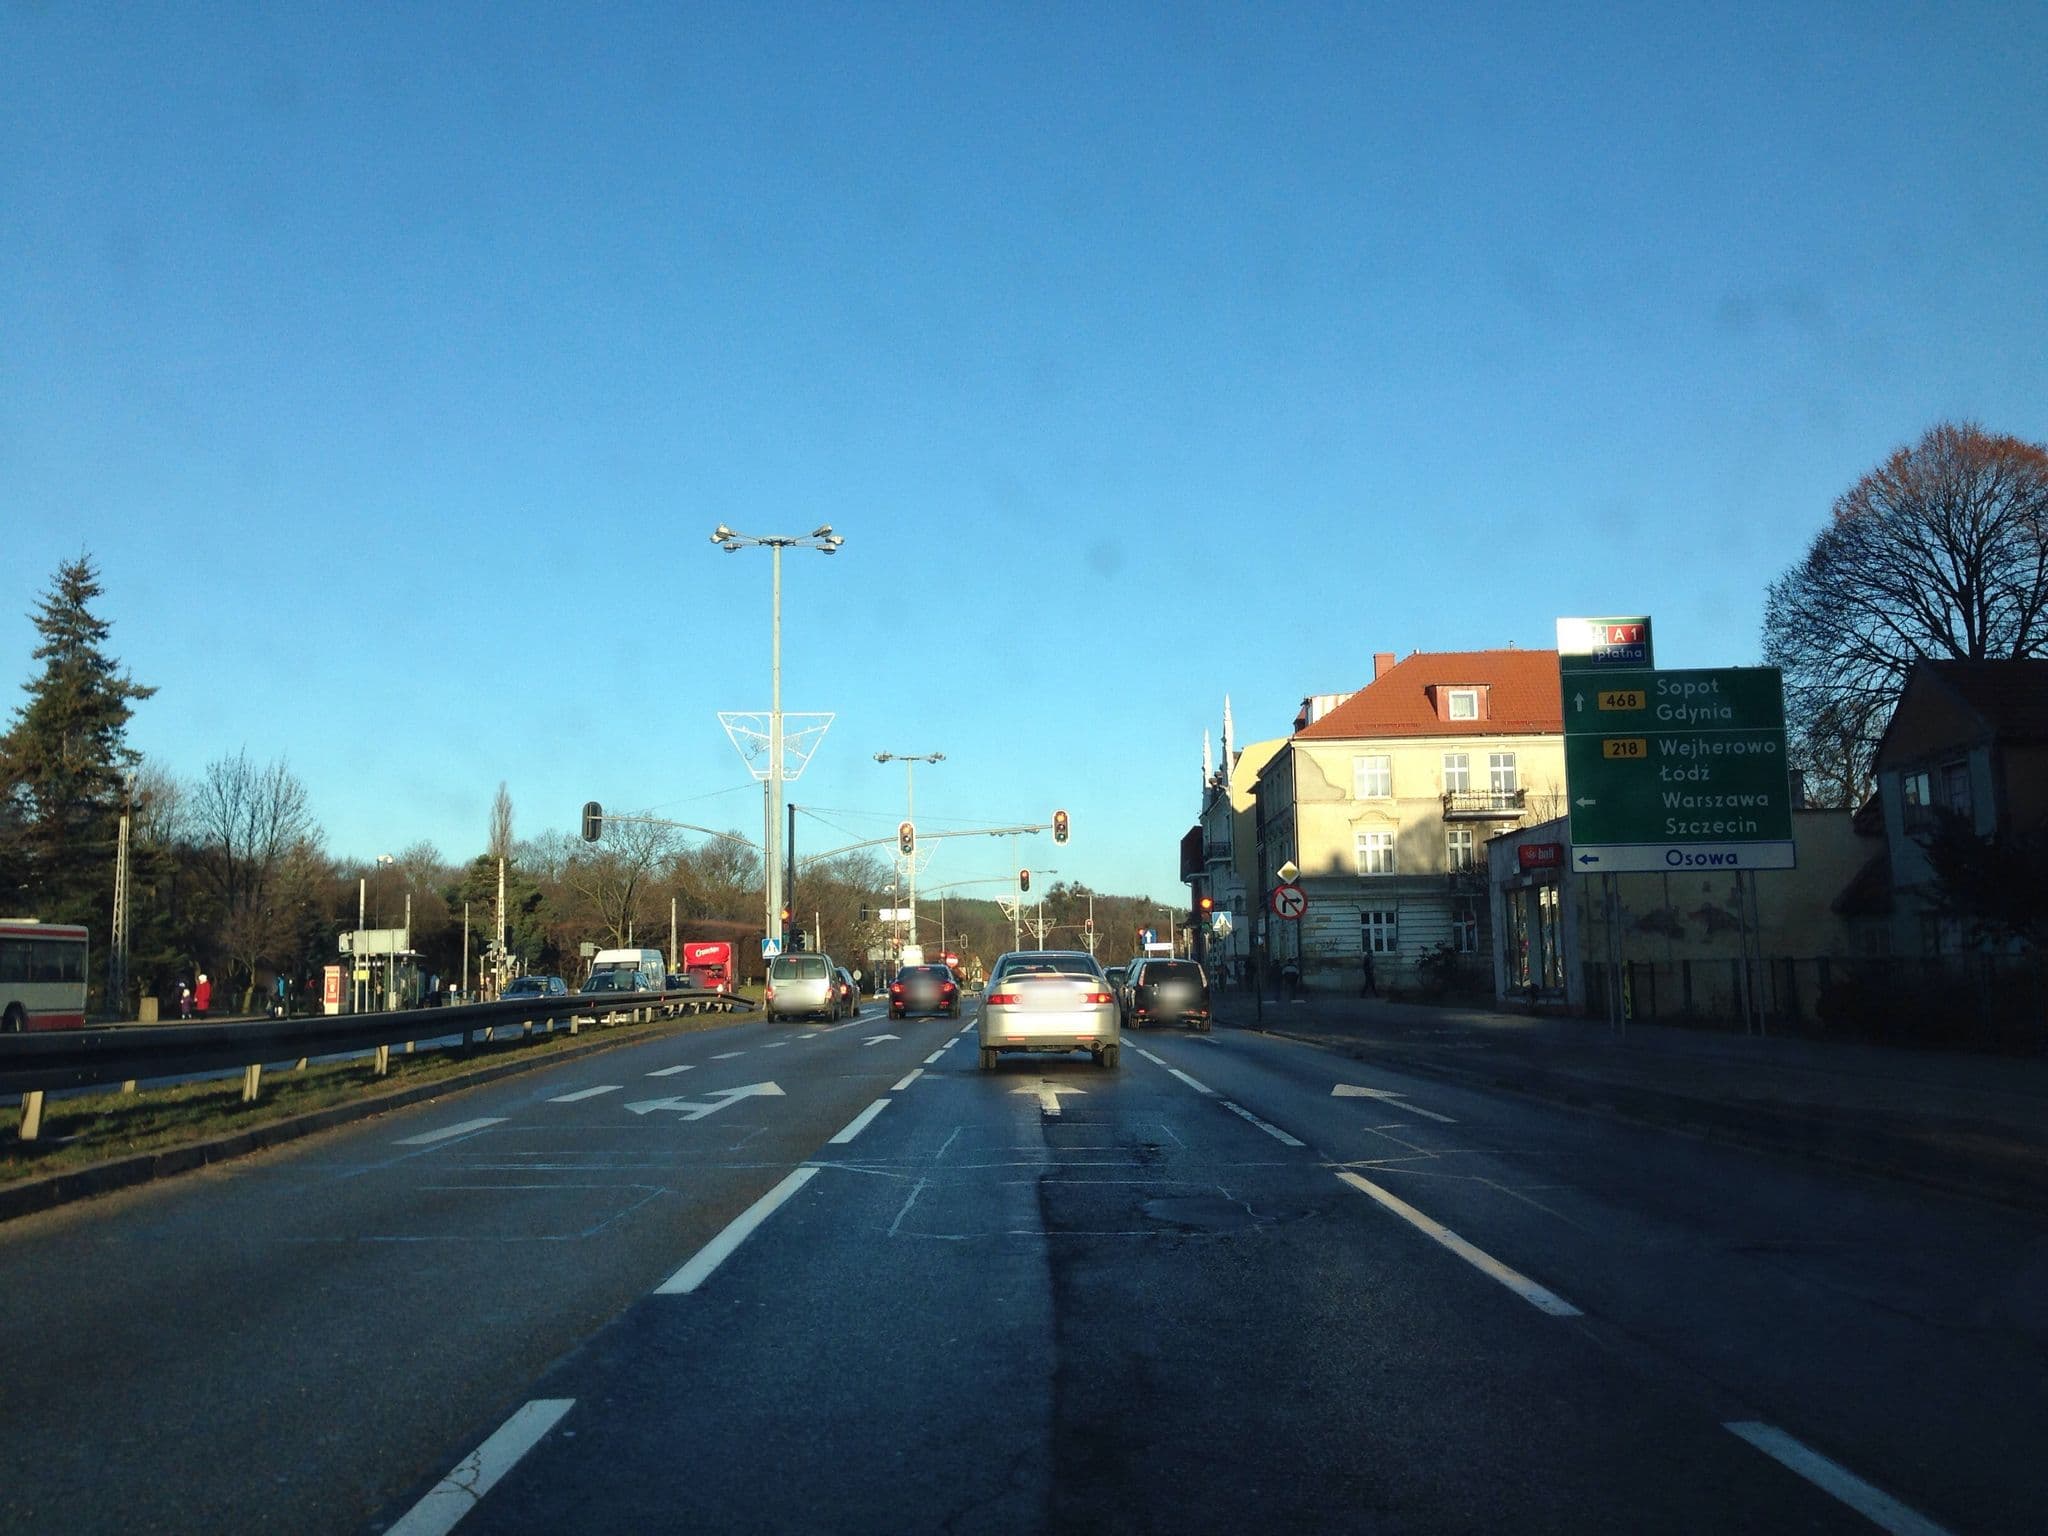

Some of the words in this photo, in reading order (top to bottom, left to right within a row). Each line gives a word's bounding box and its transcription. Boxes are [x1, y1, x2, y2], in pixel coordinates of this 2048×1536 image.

[1598, 647, 1642, 661] płatna
[1656, 678, 1720, 699] Sopot
[1606, 694, 1637, 707] 468
[1656, 703, 1733, 725] Gdynia
[1612, 742, 1638, 756] 218
[1659, 738, 1777, 759] Wejherowo
[1659, 763, 1710, 782] Łódź
[1662, 792, 1769, 809] Warszawa
[1665, 817, 1758, 835] Szczecin
[1665, 849, 1738, 867] Osowa
